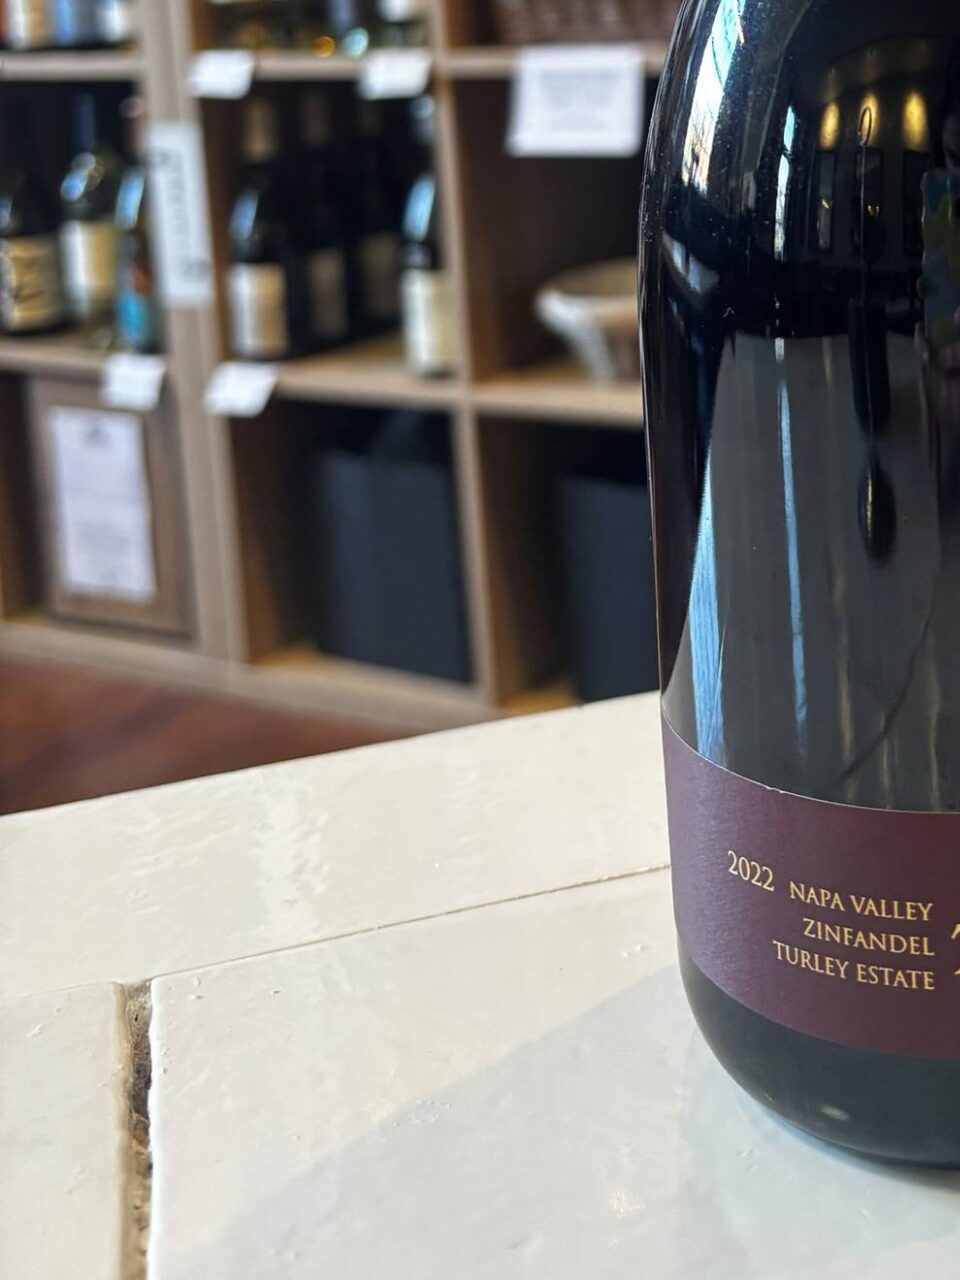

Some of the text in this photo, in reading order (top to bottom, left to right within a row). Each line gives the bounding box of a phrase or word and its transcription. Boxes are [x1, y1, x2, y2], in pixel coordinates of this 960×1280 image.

[727, 849, 934, 921] 2022 NAPA VALLEY
[803, 917, 935, 956] ZINFANDEL
[772, 939, 935, 991] TURLEY ESTATE
